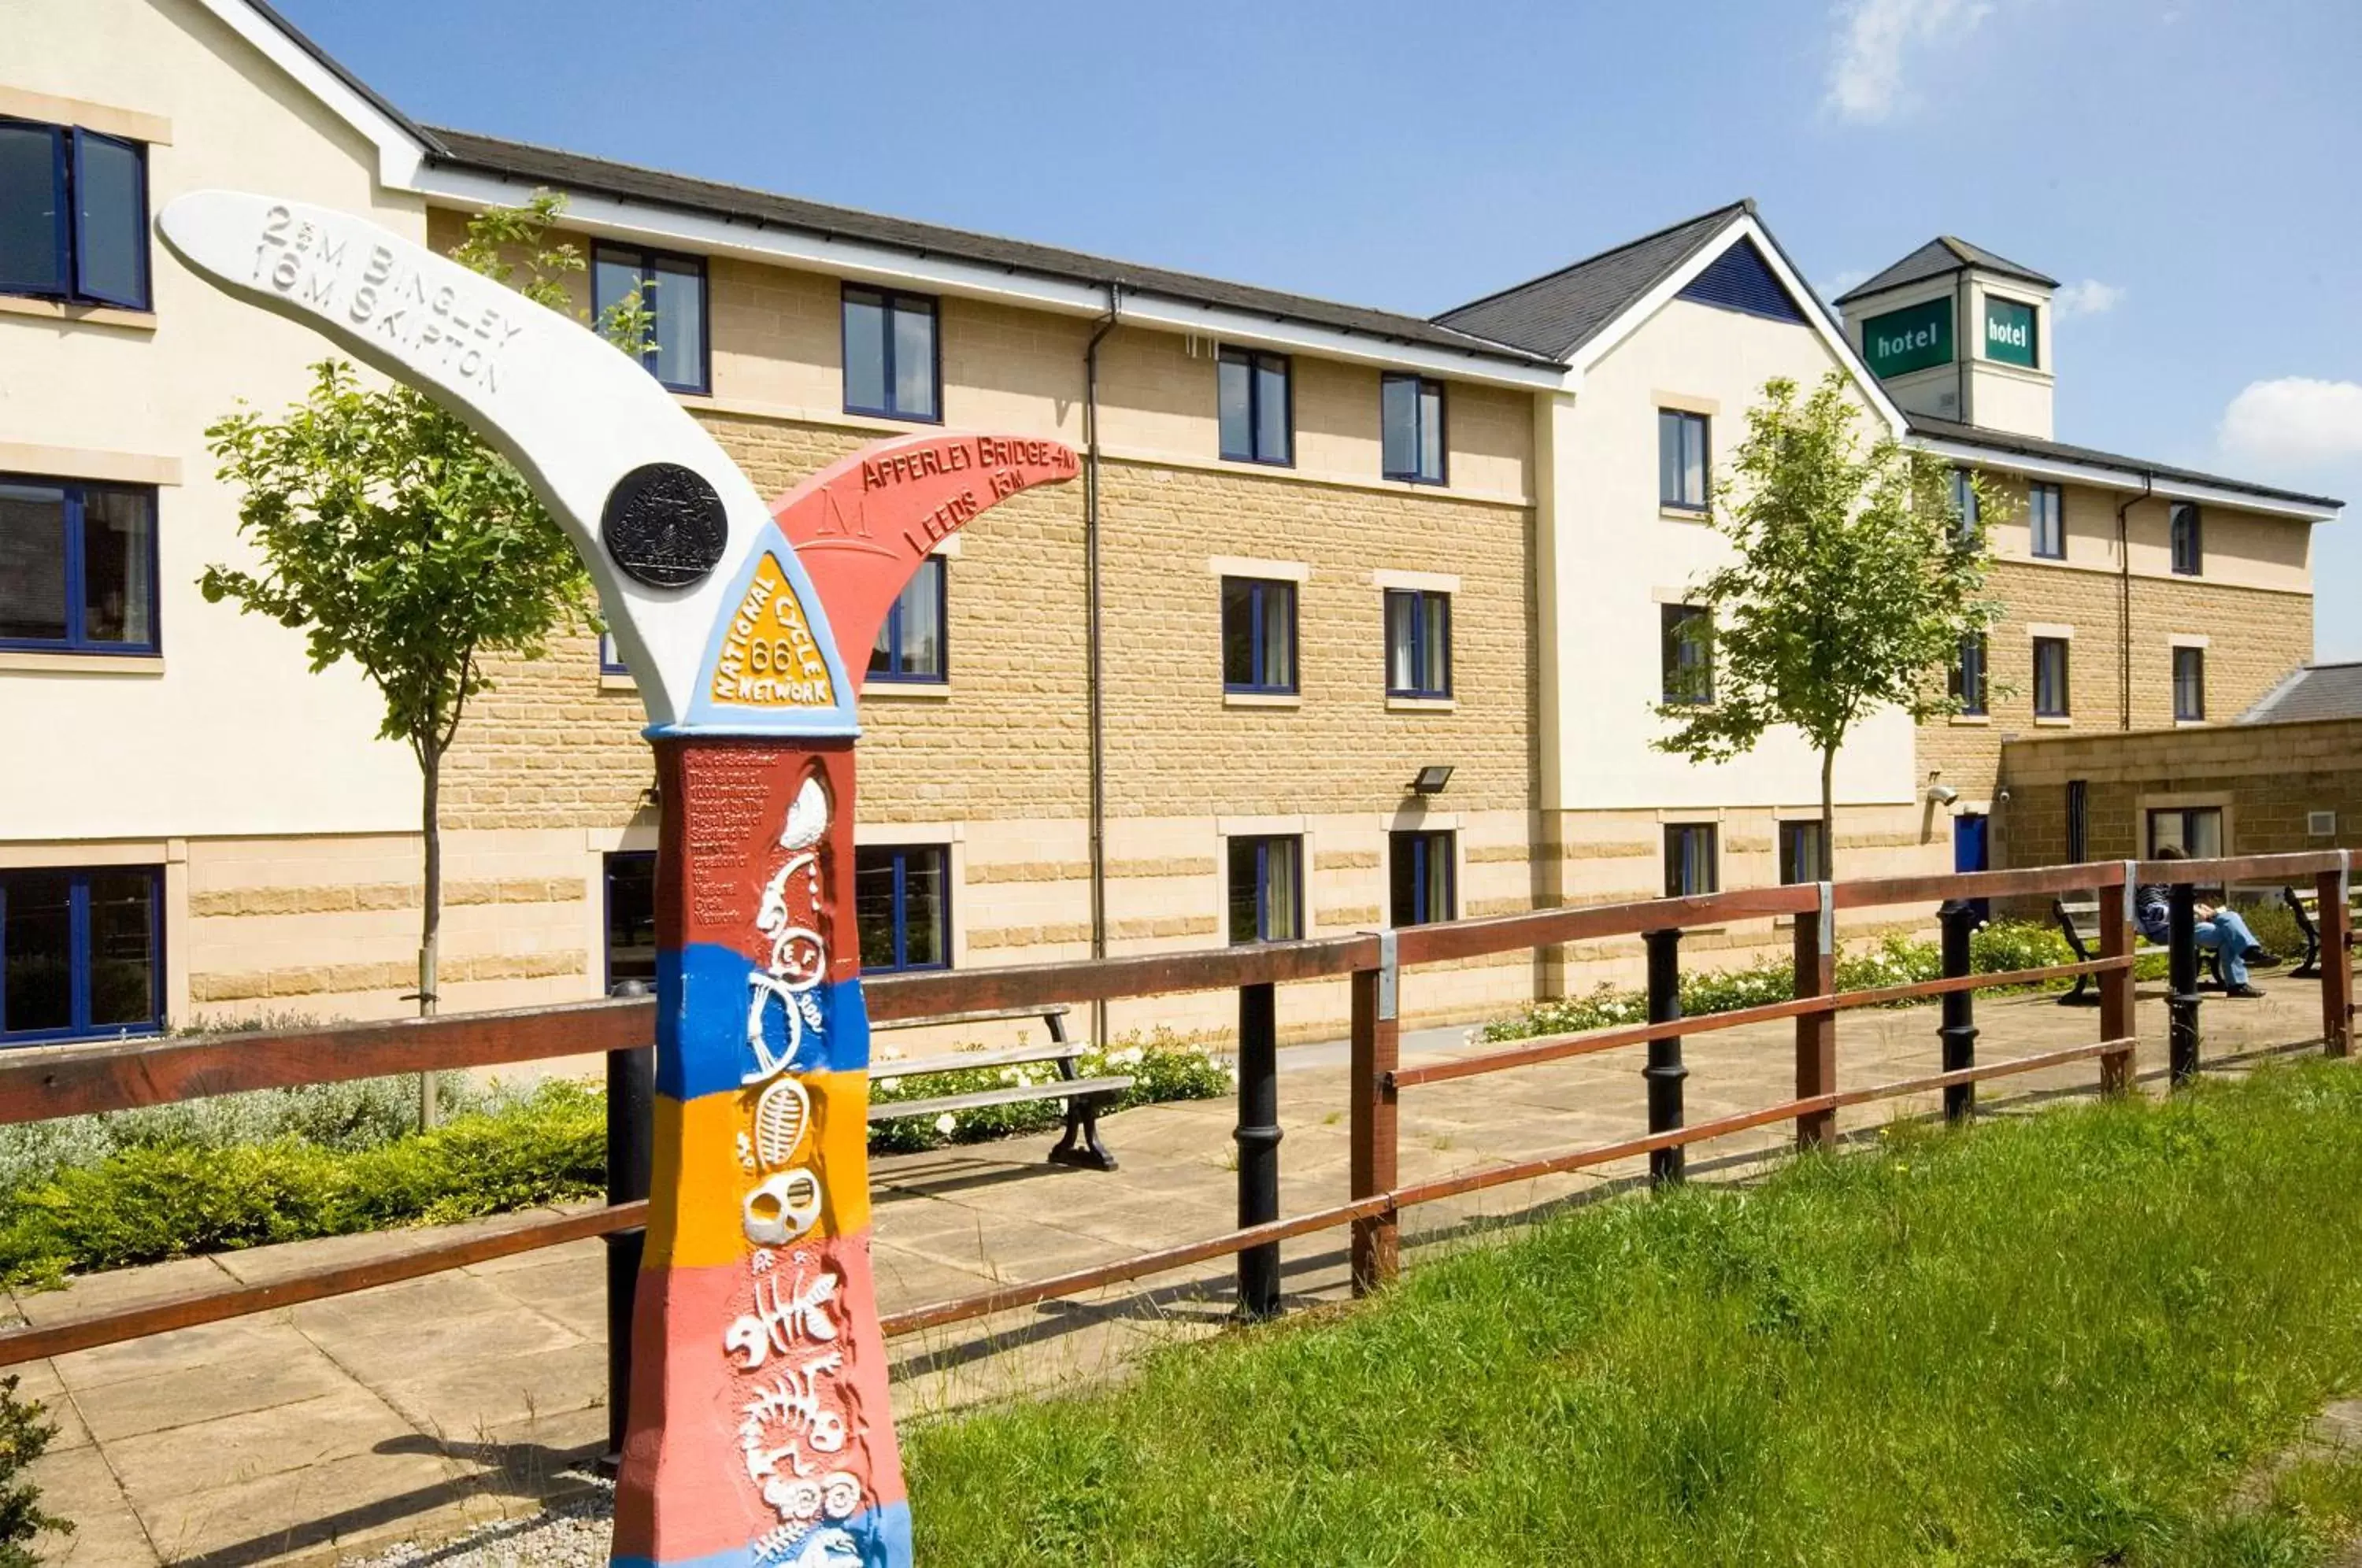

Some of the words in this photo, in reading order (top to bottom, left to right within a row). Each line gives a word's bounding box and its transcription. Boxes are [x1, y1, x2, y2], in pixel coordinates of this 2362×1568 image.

[362, 245, 523, 348] BINGLEY
[349, 287, 504, 394] SKIPTON
[1878, 322, 1936, 358] hotel
[1989, 318, 2026, 348] hotel
[862, 444, 972, 493] APPERLEY
[976, 436, 1050, 468] BRIDGE
[903, 490, 977, 557] LEEDS
[716, 576, 776, 699] NATIONAL
[752, 637, 790, 674] 66
[775, 596, 821, 679] CYCLE
[738, 677, 827, 703] NETWORK
[689, 784, 716, 798] 1000
[690, 812, 722, 827] Royal
[690, 826, 737, 840] Scotland
